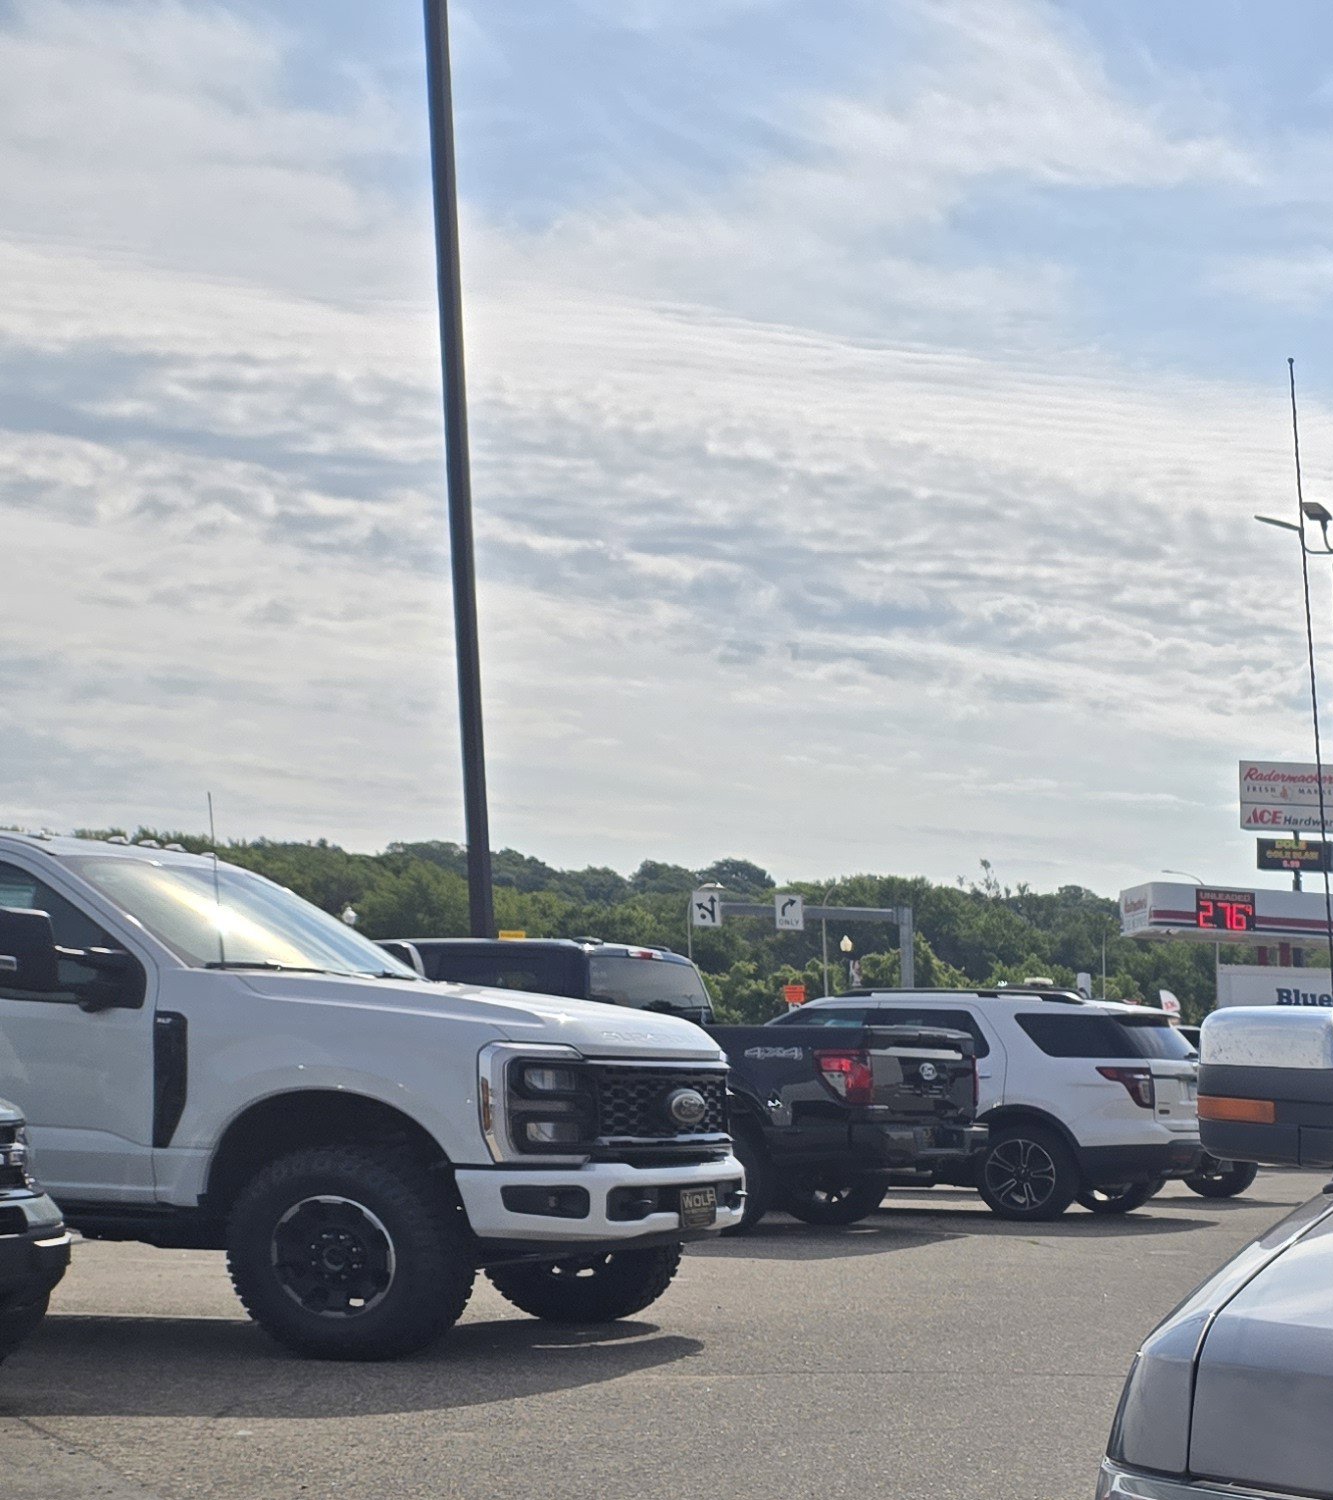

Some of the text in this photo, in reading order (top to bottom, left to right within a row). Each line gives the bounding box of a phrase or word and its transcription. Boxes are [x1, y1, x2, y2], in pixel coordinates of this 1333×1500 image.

[1246, 808, 1284, 825] ACE
[1200, 892, 1250, 901] UNLEADED
[1276, 988, 1332, 1007] Blue
[682, 1193, 715, 1208] WOLF
